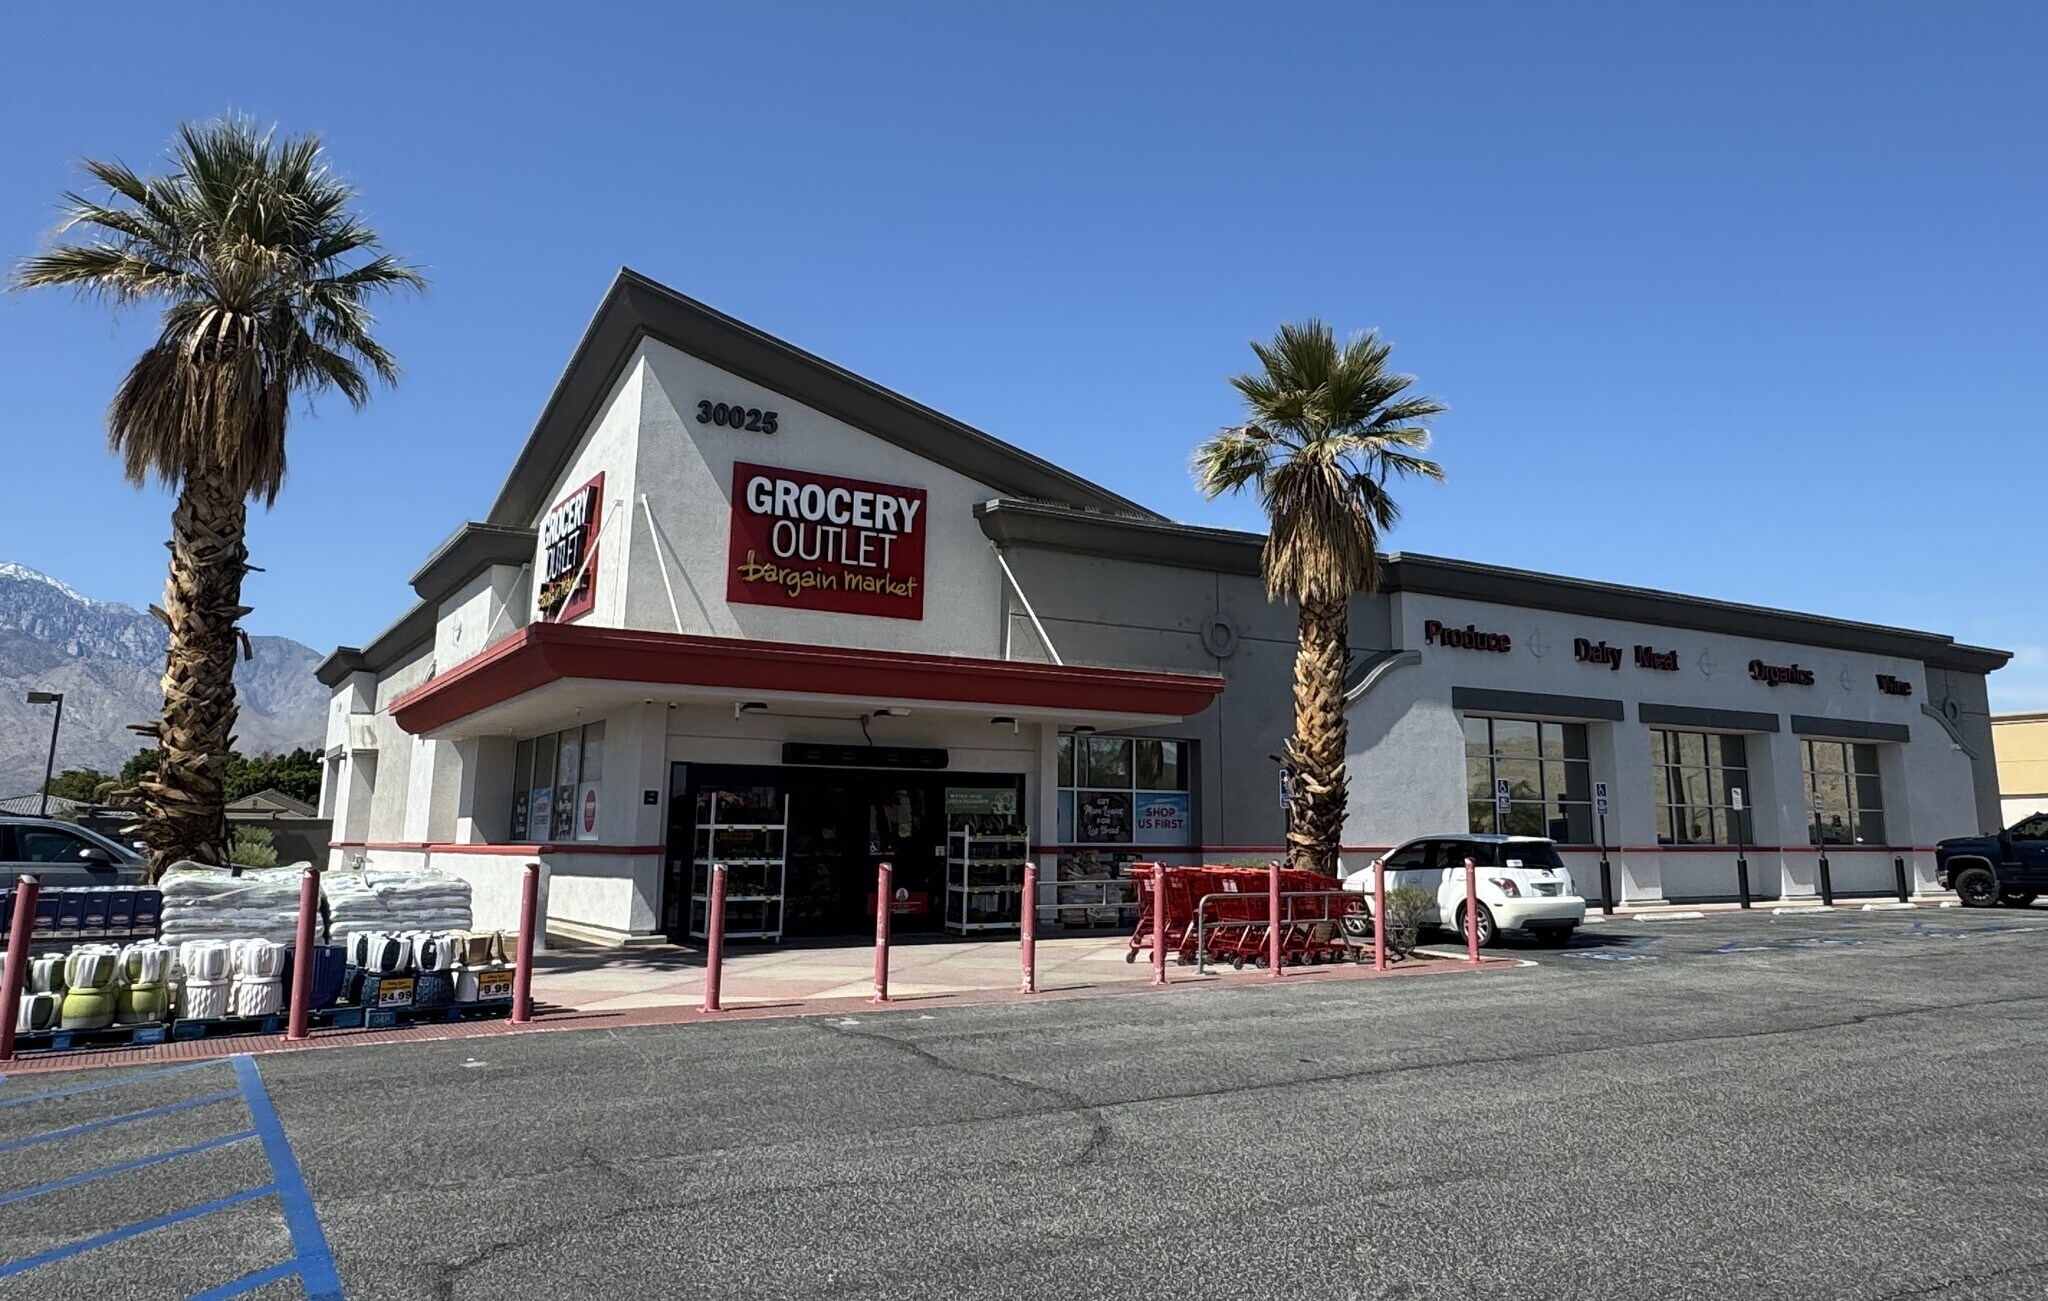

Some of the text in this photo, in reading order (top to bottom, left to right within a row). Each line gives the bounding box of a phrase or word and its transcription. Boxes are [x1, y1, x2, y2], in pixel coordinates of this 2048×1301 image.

[696, 400, 779, 435] 30025
[746, 476, 921, 534] GROCERY
[772, 519, 898, 570] OUTLET
[737, 549, 918, 598] bargain market
[1424, 619, 1512, 653] Produce
[1573, 637, 1680, 671] Dairy Meat
[1748, 658, 1815, 688] Organics
[1875, 673, 1913, 697] Wine
[1137, 819, 1184, 829] US FIRST
[1145, 807, 1176, 817] SHOP
